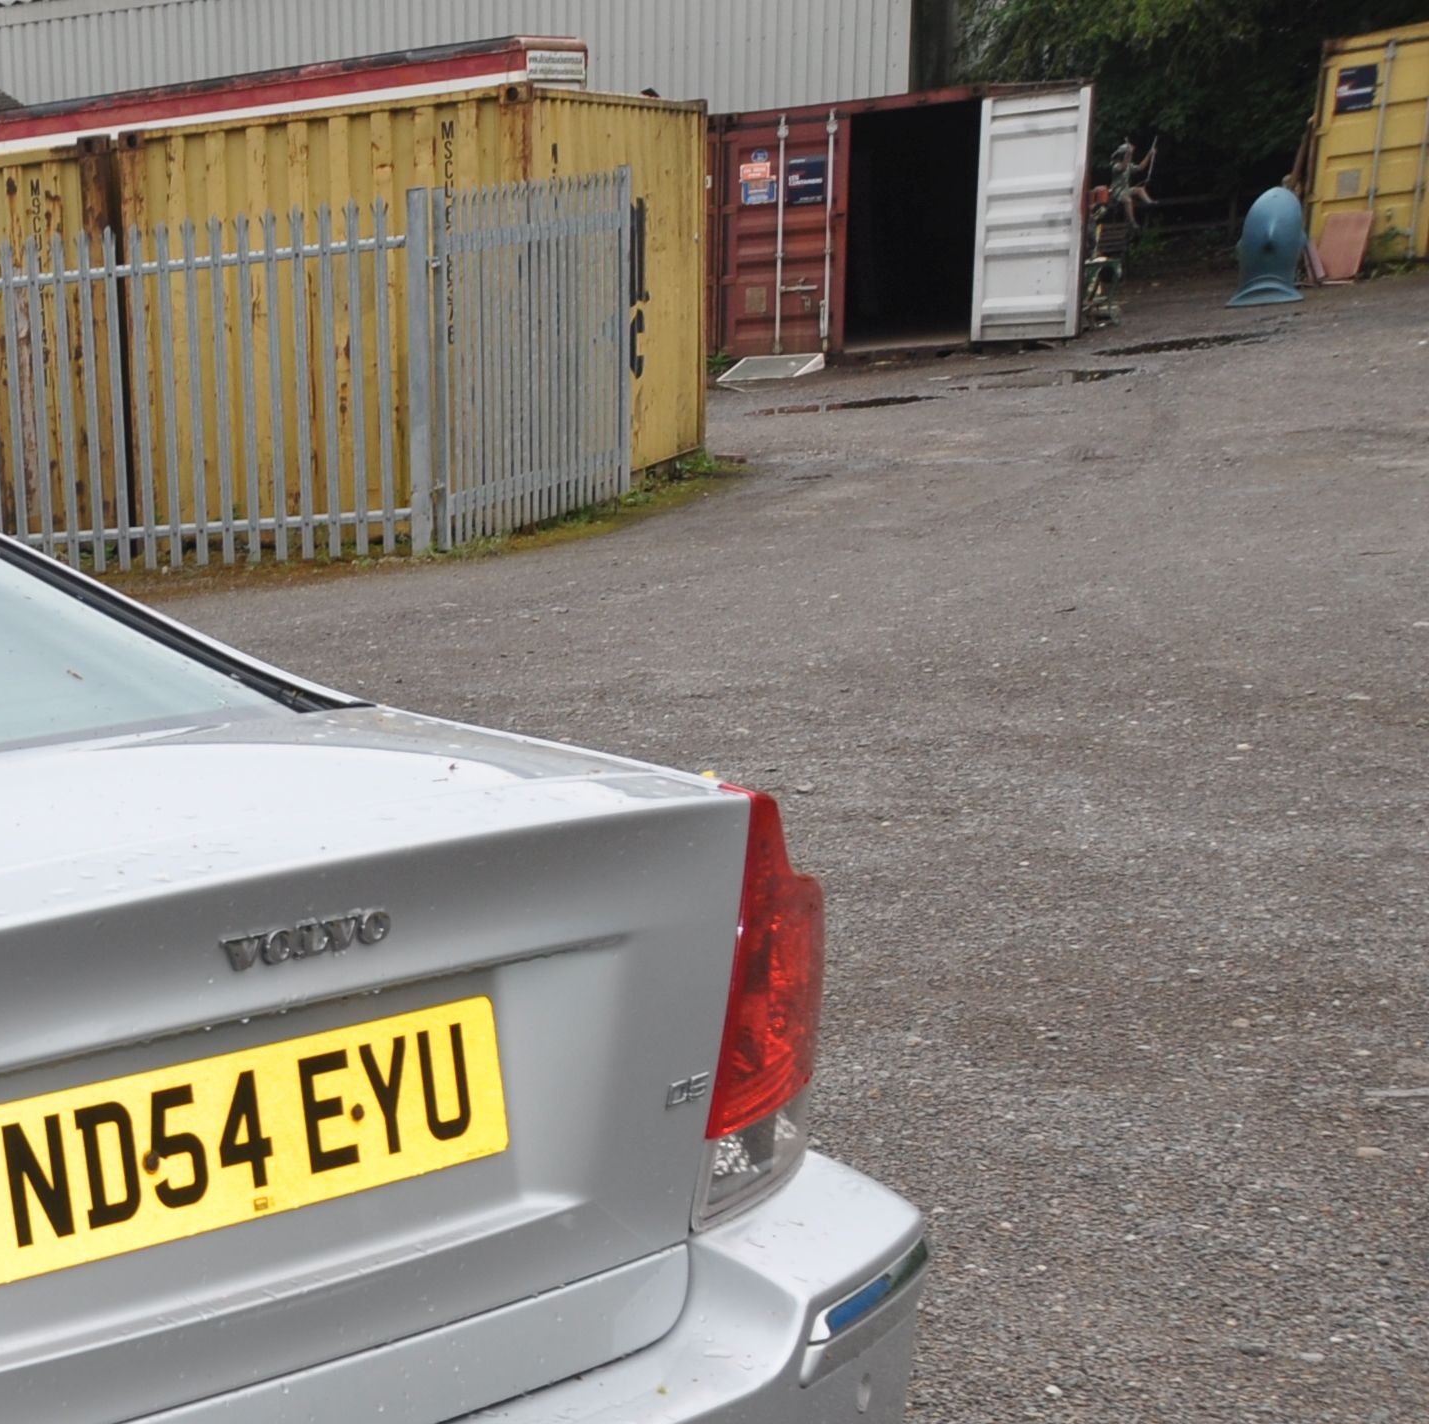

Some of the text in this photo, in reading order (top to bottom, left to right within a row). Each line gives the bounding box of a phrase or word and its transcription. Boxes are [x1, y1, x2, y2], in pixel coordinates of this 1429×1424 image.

[220, 907, 390, 972] VOLVO
[665, 1070, 710, 1109] D5
[1, 1022, 492, 1248] ND54 EYU
